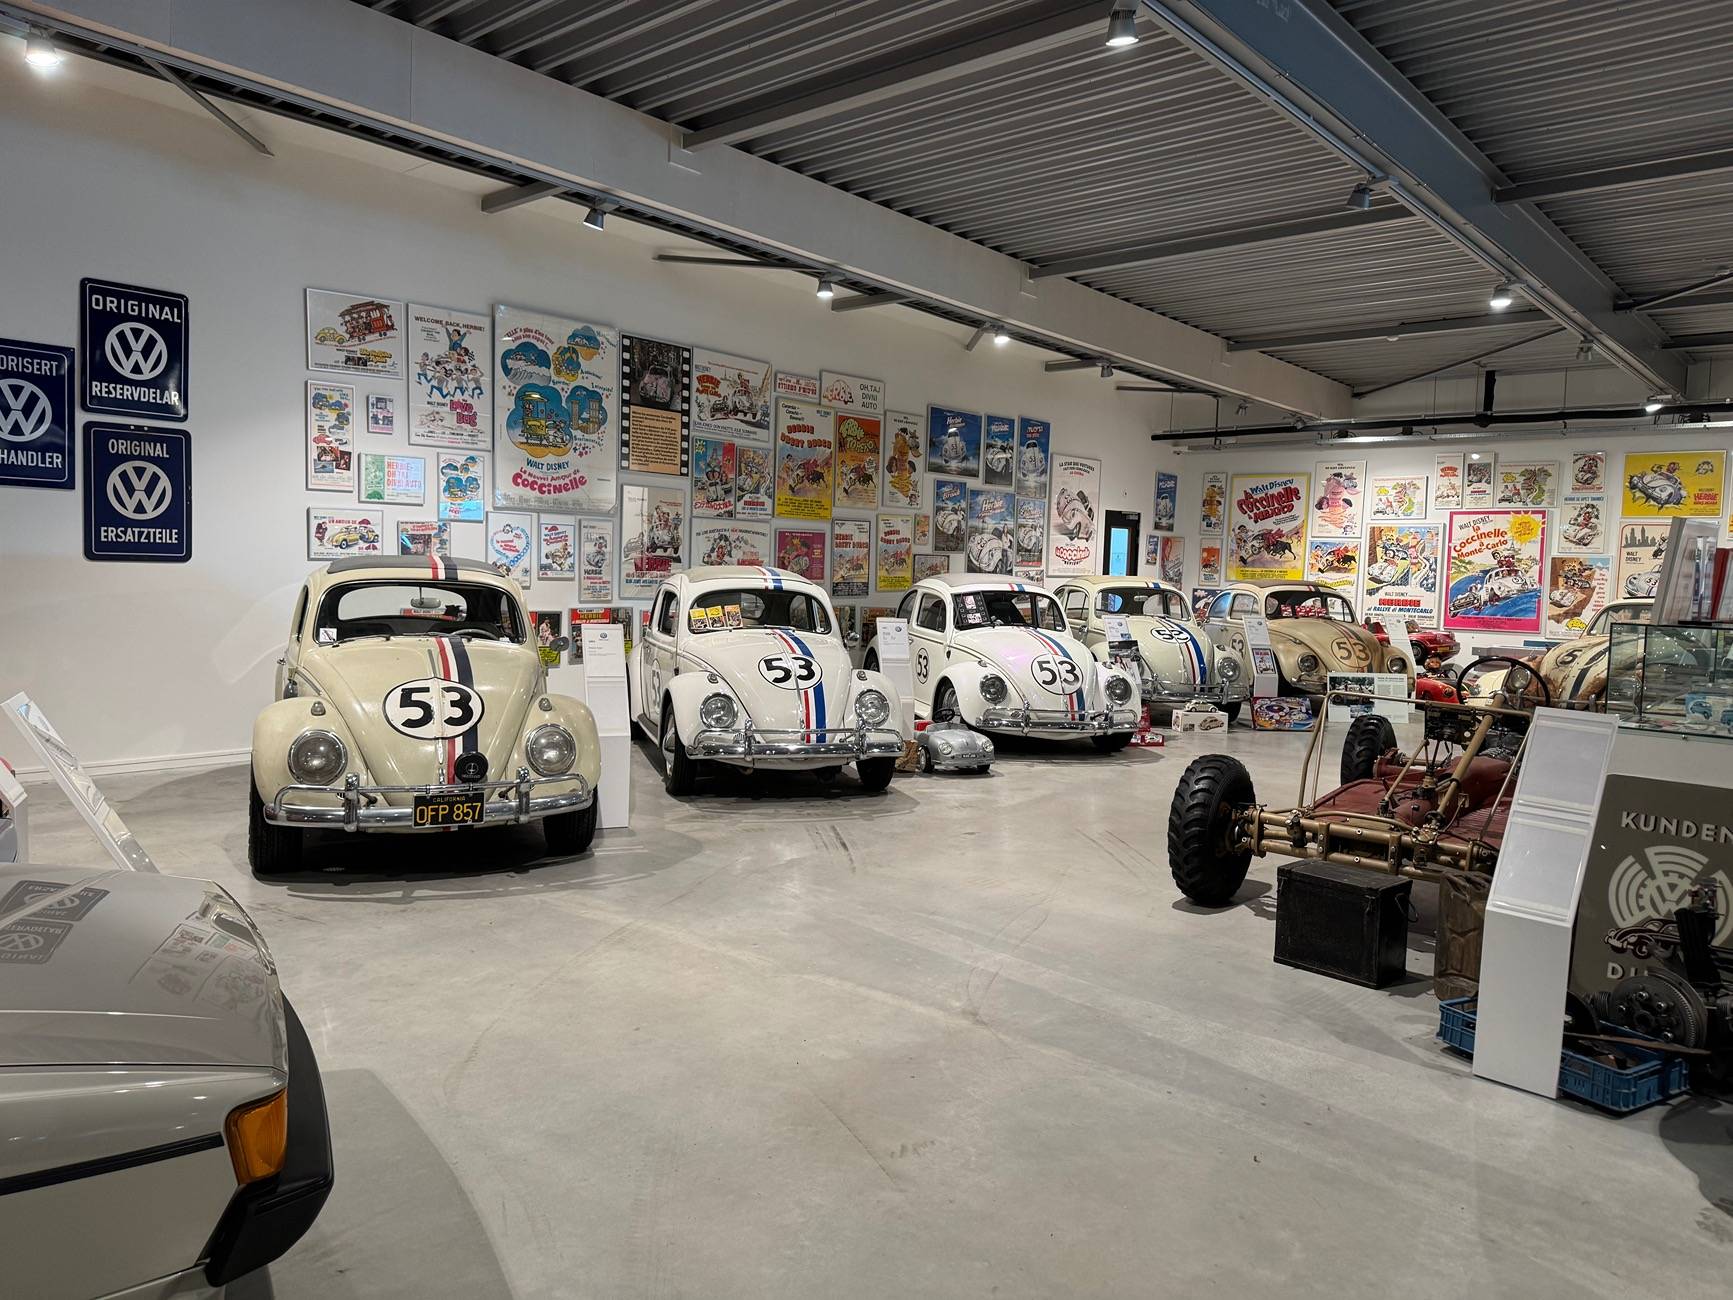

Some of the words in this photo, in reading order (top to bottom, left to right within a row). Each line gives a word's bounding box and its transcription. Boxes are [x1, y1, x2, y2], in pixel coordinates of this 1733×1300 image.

[91, 294, 181, 323] ORIGINAL
[414, 315, 444, 325] WELCOME
[0, 354, 58, 376] ORISERT
[91, 381, 179, 406] RESERVDELAR
[861, 393, 878, 401] DIVNI
[861, 401, 877, 410] AUTO
[108, 438, 169, 458] ORIGINAL
[0, 450, 62, 468] HANDLER
[526, 458, 544, 470] WALT
[546, 460, 570, 471] DISNEY
[1249, 484, 1269, 495] Walt
[1269, 478, 1294, 489] Disney
[1237, 486, 1301, 514] Coccinelle
[1458, 521, 1472, 530] WALT
[1472, 515, 1490, 526] DISNEY
[1472, 525, 1481, 533] la
[100, 526, 178, 544] ERSATZTEILE
[1453, 528, 1508, 553] Coccinelle
[1456, 539, 1508, 561] Monte-Carlo
[1646, 577, 1658, 587] 53
[1155, 629, 1189, 641] 53
[1336, 641, 1370, 662] 53
[763, 656, 816, 684] 53
[917, 654, 929, 679] 53
[1036, 660, 1082, 686] 53
[400, 687, 474, 728] 53
[453, 802, 481, 822] 857
[1621, 811, 1733, 844] KUNDEN
